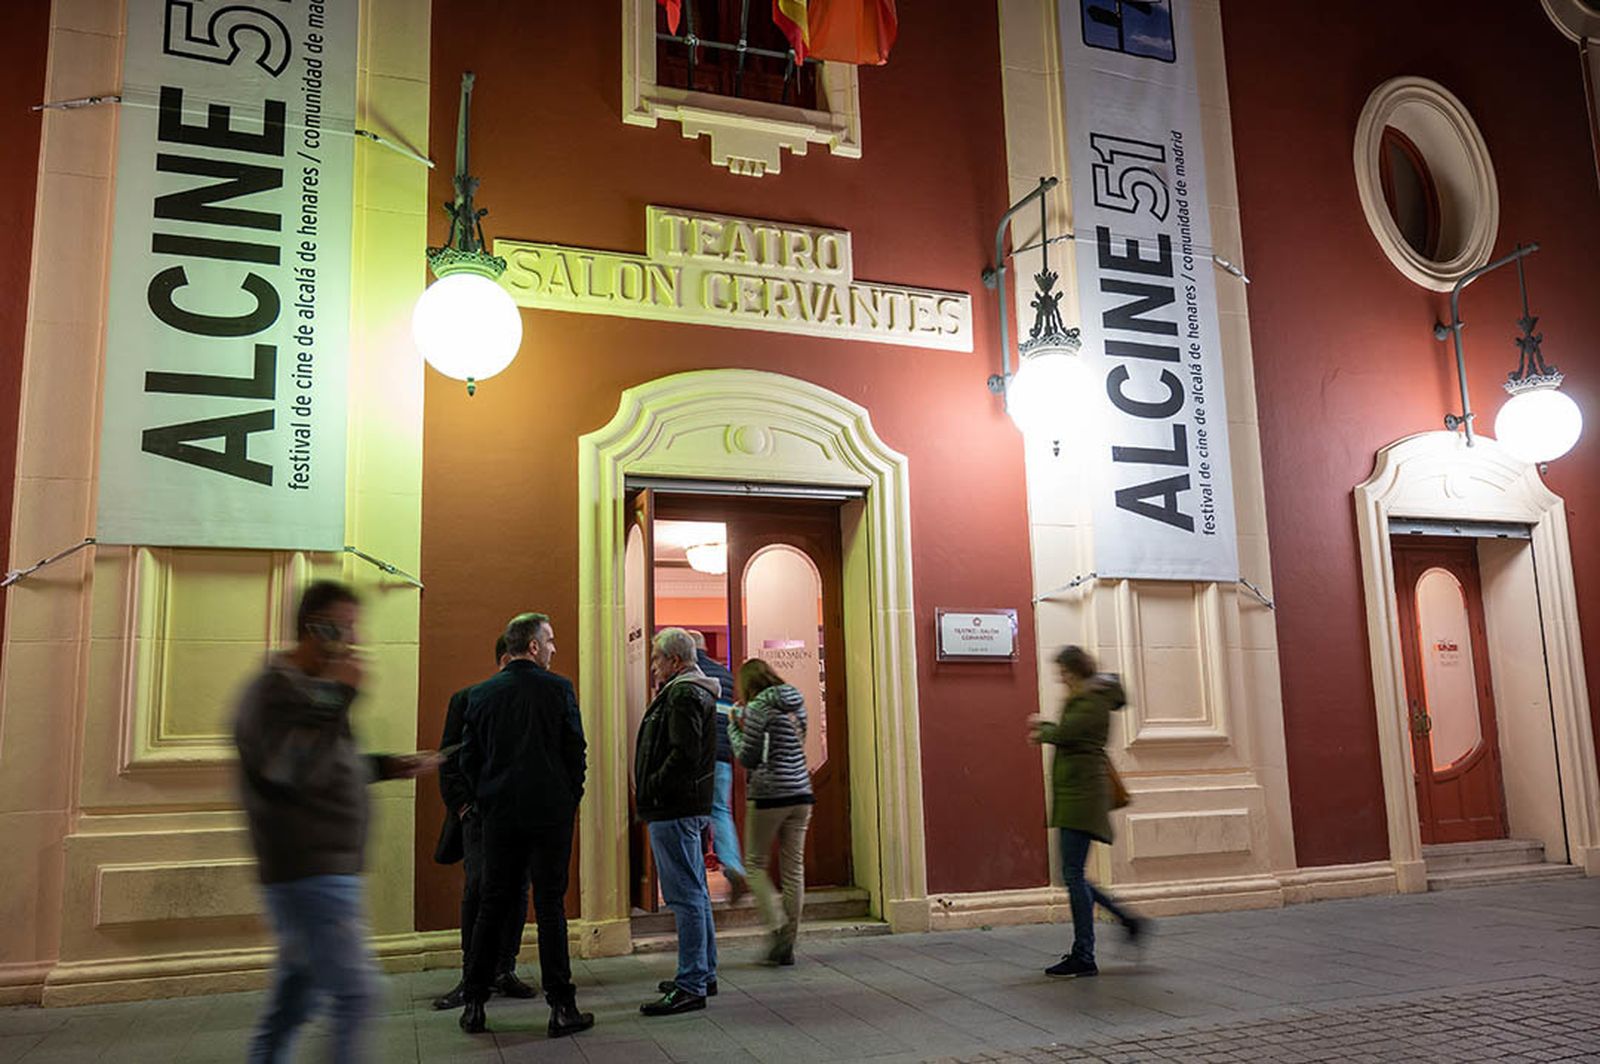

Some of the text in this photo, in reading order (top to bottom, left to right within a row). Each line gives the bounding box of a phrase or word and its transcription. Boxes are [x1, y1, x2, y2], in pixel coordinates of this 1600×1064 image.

[303, 33, 324, 53] de
[302, 57, 323, 149] comunidad
[1171, 130, 1186, 177] madrid
[297, 167, 319, 236] henares
[1174, 180, 1187, 197] de
[142, 0, 292, 487] ALCINE 5
[296, 241, 317, 262] de
[659, 212, 845, 274] TEATRO
[1176, 199, 1194, 271] comunidad
[294, 267, 316, 320] alcalá
[507, 248, 961, 335] SALON CERVANTES
[1185, 285, 1199, 339] henares
[293, 325, 314, 346] de
[1089, 132, 1195, 533] ALCINE 51
[1188, 343, 1202, 360] de
[291, 352, 313, 389] cine
[1188, 363, 1205, 404] alcalá
[291, 395, 311, 417] de
[1193, 408, 1206, 425] de
[288, 423, 311, 489] festival
[1196, 429, 1209, 458] cine
[1198, 462, 1211, 479] de
[1200, 483, 1216, 535] festival
